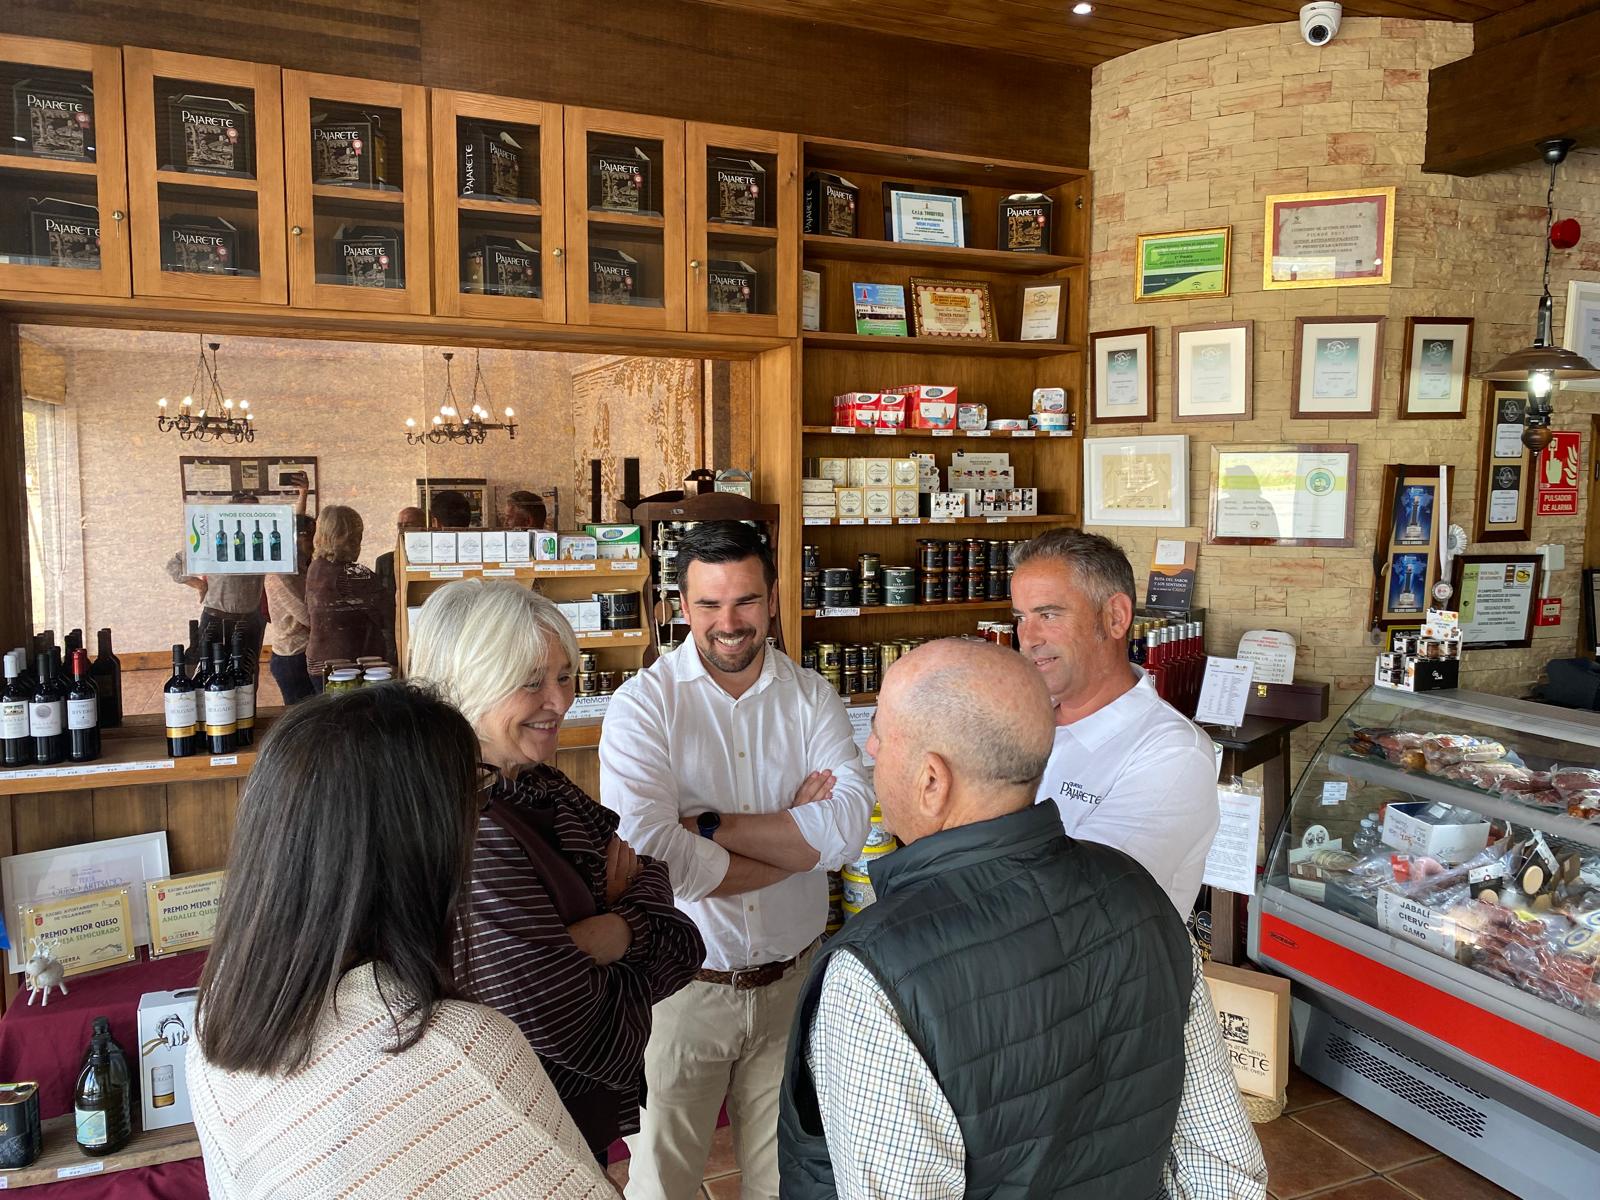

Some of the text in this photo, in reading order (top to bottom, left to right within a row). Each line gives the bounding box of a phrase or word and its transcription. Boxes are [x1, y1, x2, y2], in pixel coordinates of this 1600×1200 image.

[27, 94, 83, 113] PAJARETE
[182, 110, 234, 128] PAJARETE
[463, 143, 473, 195] PAJARETE
[599, 159, 639, 175] PAJARETE
[717, 171, 756, 185] PAJARETE
[826, 185, 853, 202] PAJARETE
[1006, 207, 1043, 218] PAJARETE
[171, 230, 223, 247] PAJARETE
[343, 245, 386, 257] PAJARETE
[494, 251, 530, 268] PAJARETE
[593, 261, 630, 277] PAJARETE
[708, 272, 748, 287] PAJARETE
[1544, 494, 1572, 502] PULSADOR
[238, 511, 277, 519] ECOLÓGICOS
[1060, 781, 1102, 805] PAJARETE
[162, 907, 221, 923] ANDALUZ QUES
[163, 904, 189, 915] PREMIO
[190, 900, 212, 910] MEJOR
[1400, 901, 1431, 918] JABALÍ
[40, 917, 118, 940] PREMIO MEJOR QUESO
[76, 926, 121, 941] SEMICURADO
[57, 955, 80, 965] SIERRA
[1229, 1049, 1270, 1072] RETE
